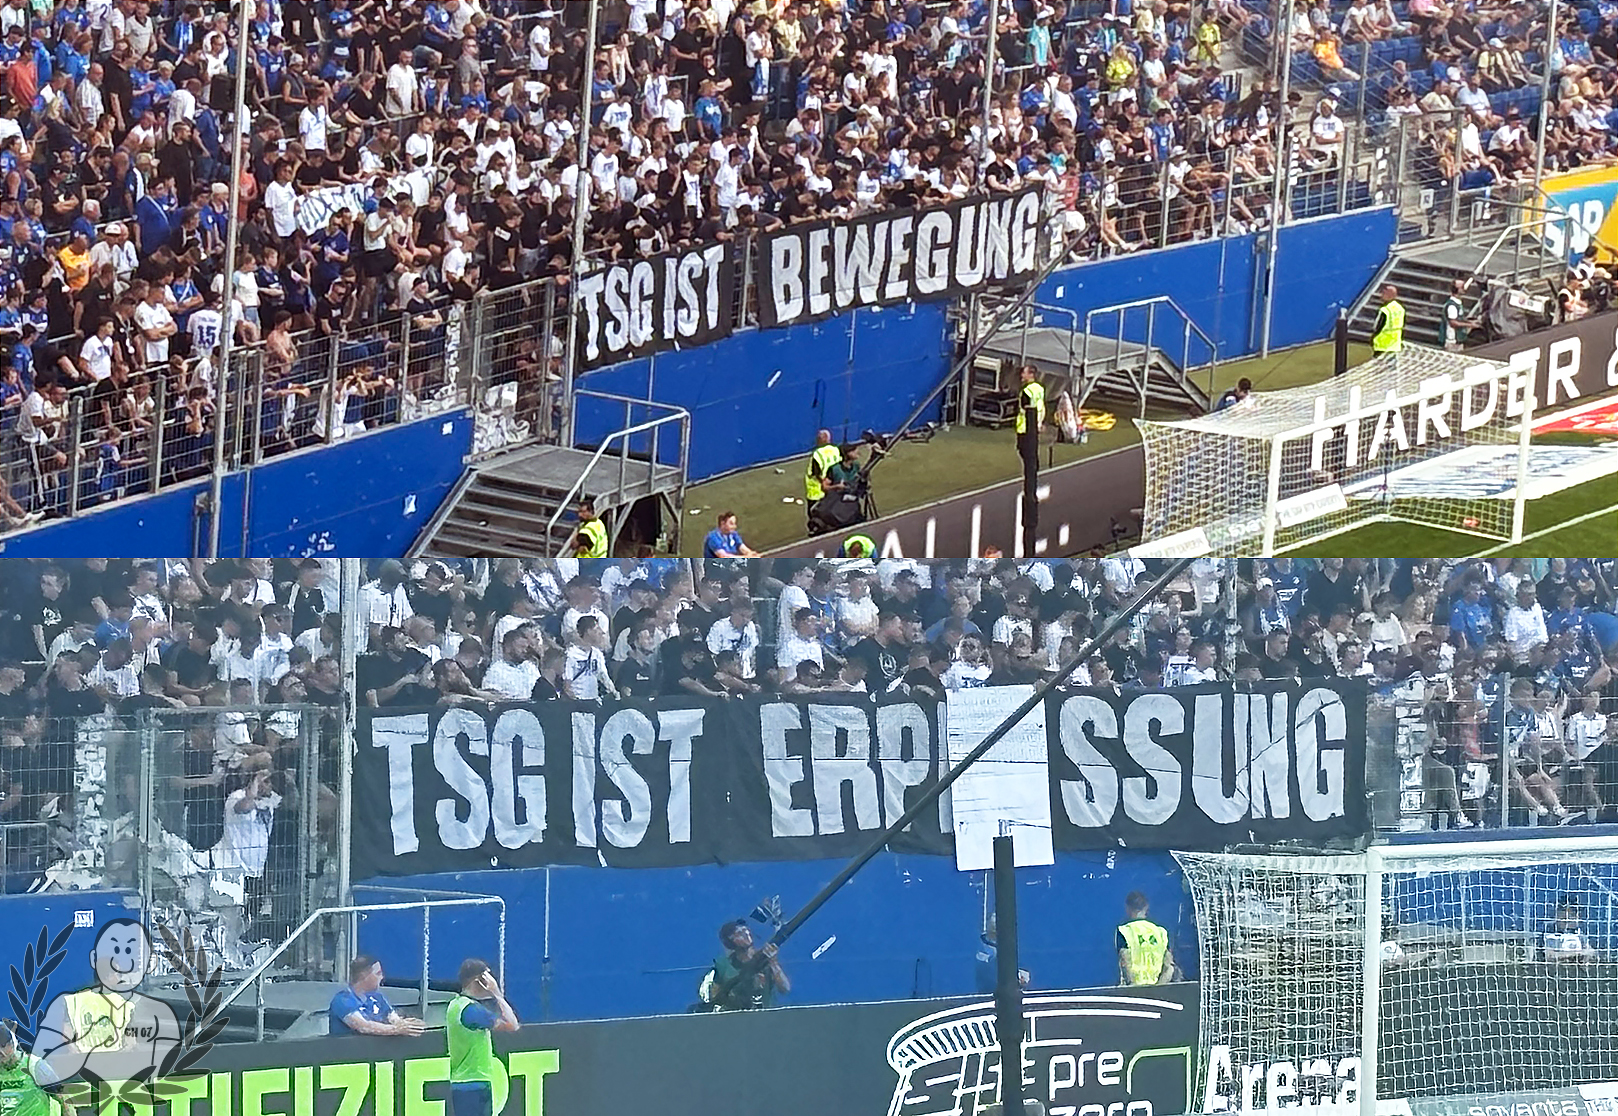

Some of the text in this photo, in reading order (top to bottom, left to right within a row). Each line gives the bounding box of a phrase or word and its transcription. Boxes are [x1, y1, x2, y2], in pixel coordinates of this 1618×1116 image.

[578, 191, 1040, 362] TSG IST BEWEGUNG
[197, 325, 217, 347] 15
[1311, 336, 1582, 471] HARDER
[372, 708, 548, 856] TSG
[571, 708, 706, 848] IST
[759, 687, 1347, 838] ERPSSUNG
[1049, 1050, 1125, 1101] pre
[1199, 1045, 1362, 1114] Arena
